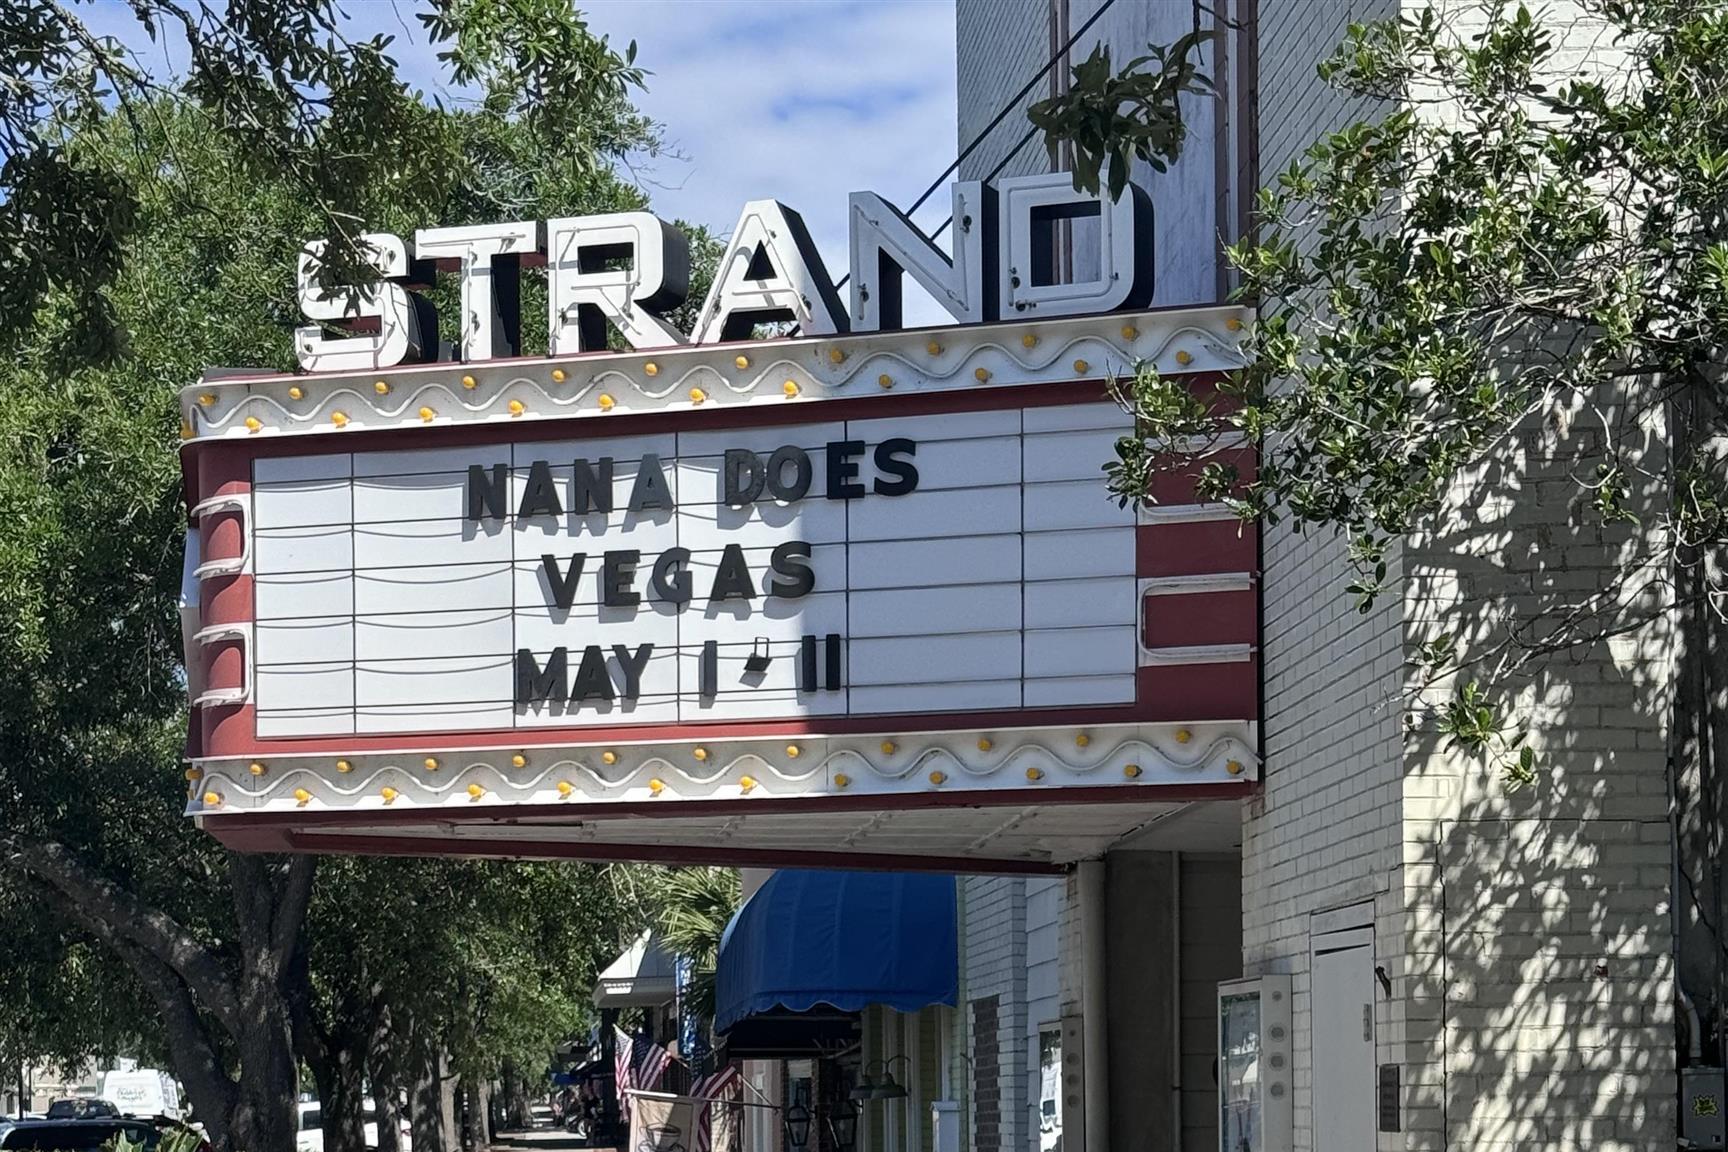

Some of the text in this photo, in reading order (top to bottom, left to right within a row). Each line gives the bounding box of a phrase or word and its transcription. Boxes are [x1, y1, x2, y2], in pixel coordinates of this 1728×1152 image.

[295, 173, 1150, 374] STRAND
[467, 438, 920, 522] NANA DOES
[540, 540, 816, 610] VEGAS
[515, 643, 655, 706] MAY
